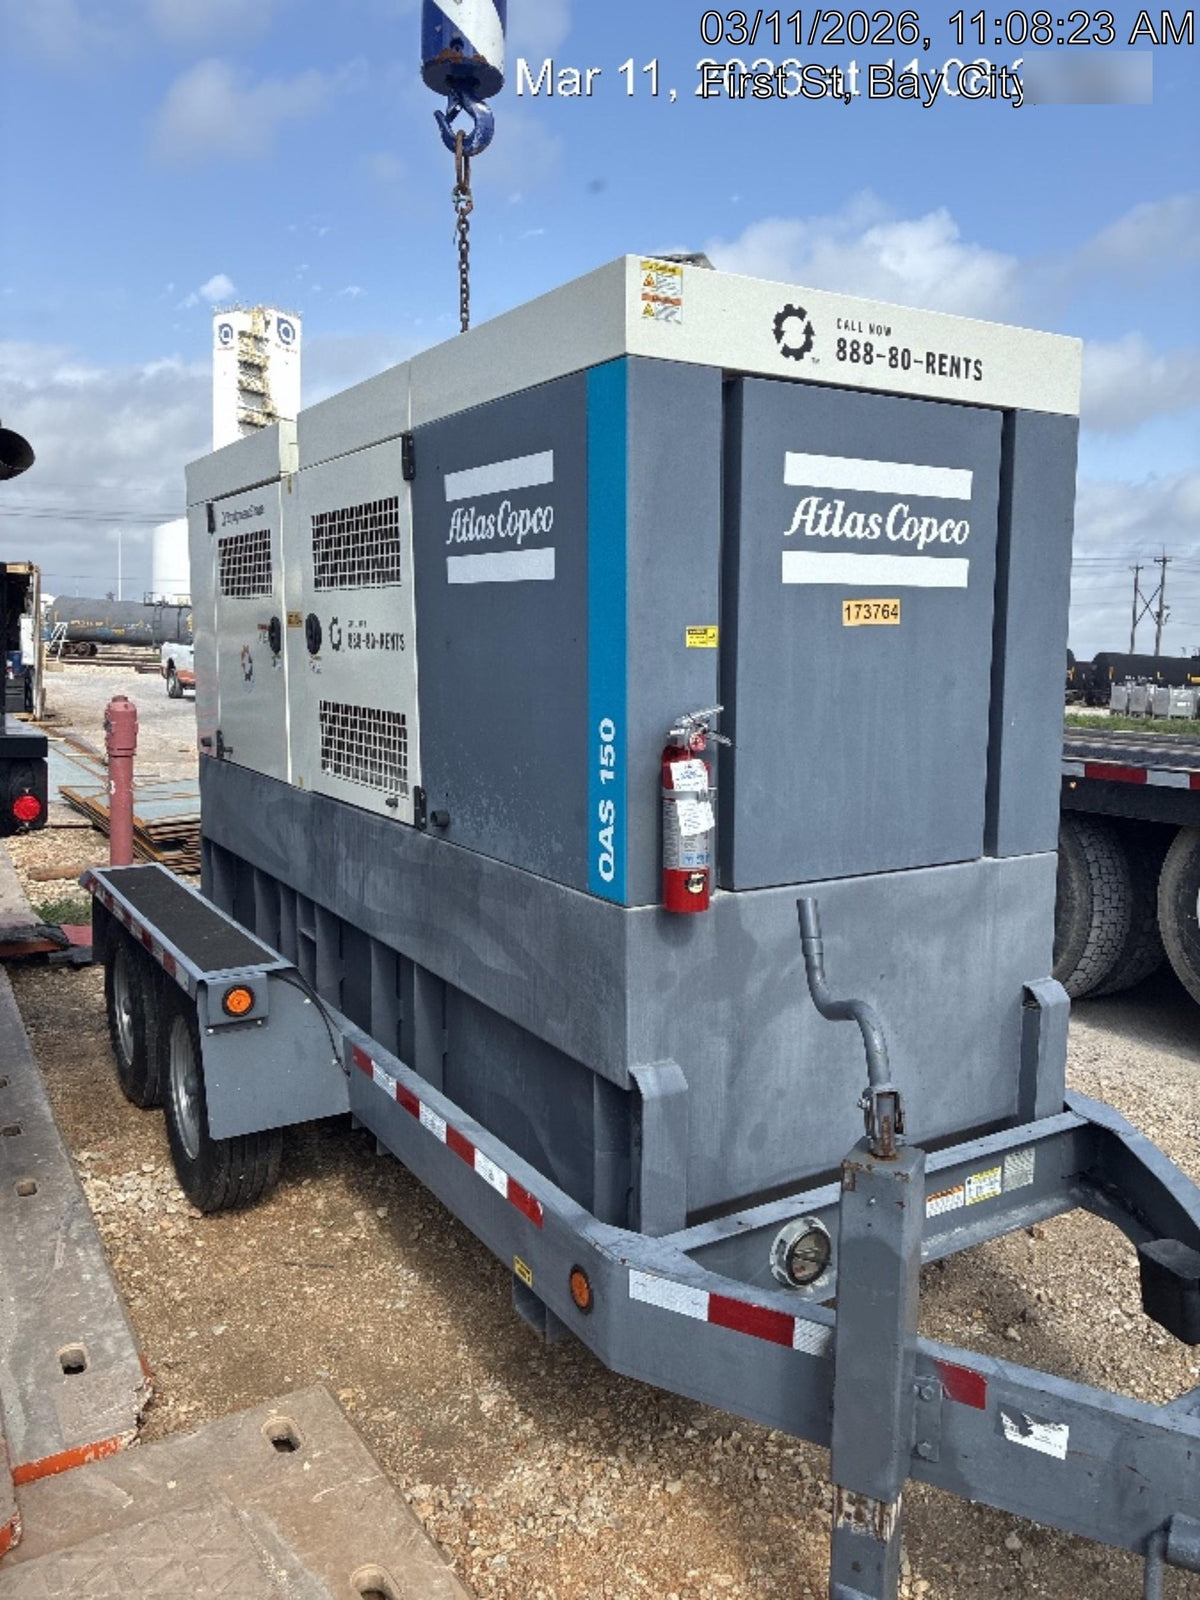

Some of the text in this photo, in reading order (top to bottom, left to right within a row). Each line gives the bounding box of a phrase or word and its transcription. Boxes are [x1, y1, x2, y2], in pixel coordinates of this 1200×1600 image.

[836, 317, 892, 337] CALL NOW
[836, 337, 983, 382] 888-80-RENTS
[445, 499, 554, 545] Atlas Copco
[783, 495, 970, 550] Atlas Copco
[844, 603, 899, 622] 173764
[598, 717, 616, 882] QAS 150
